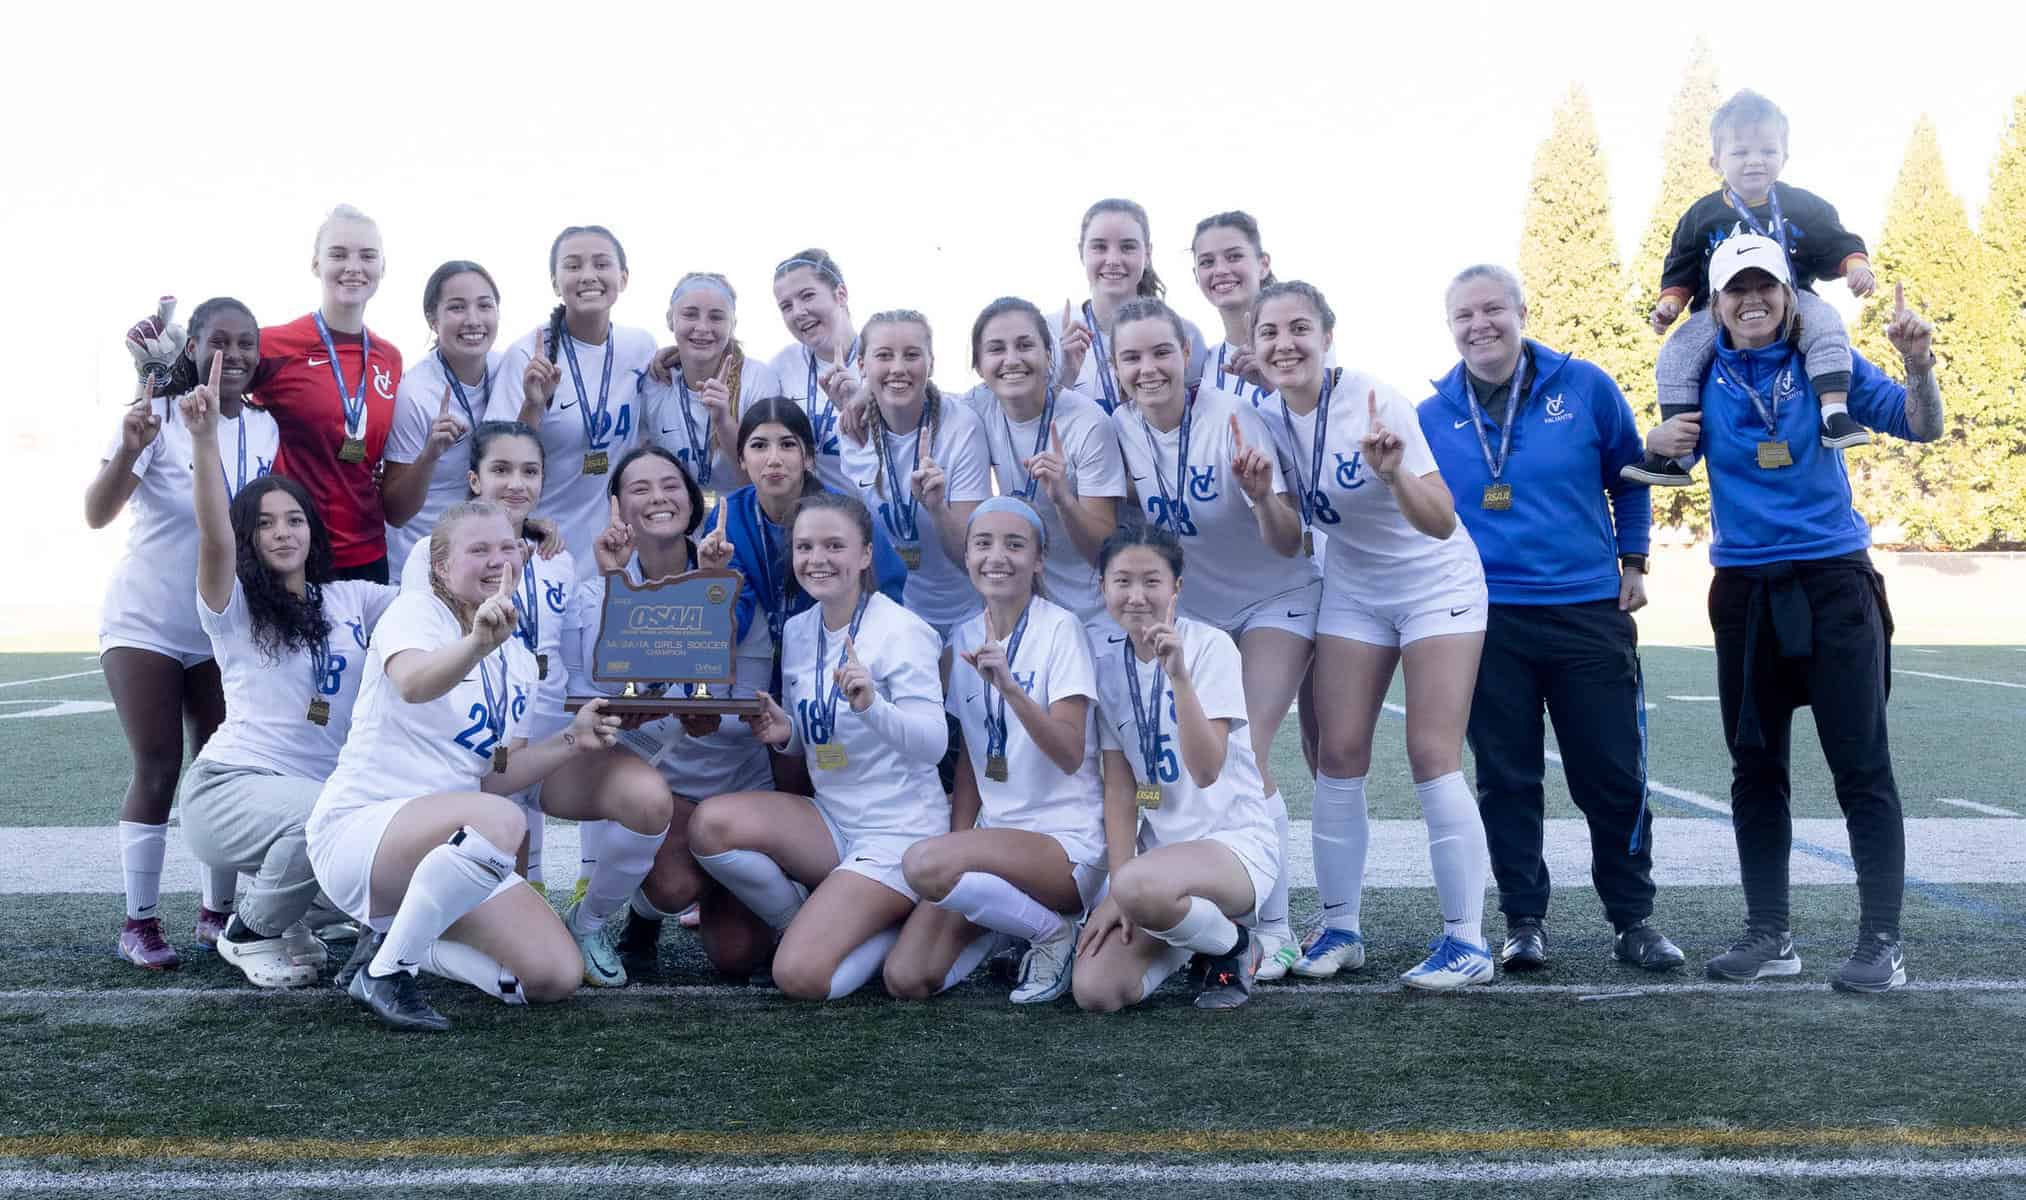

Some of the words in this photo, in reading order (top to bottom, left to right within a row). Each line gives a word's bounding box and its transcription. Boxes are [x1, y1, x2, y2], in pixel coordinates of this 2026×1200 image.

[372, 364, 395, 400] VC
[1544, 393, 1565, 416] VC
[590, 404, 631, 449] 24
[1189, 465, 1218, 501] VC
[1332, 451, 1366, 489] VC
[541, 579, 566, 614] VC
[629, 605, 704, 630] OSAA
[654, 640, 683, 649] GIRLS
[687, 640, 729, 649] SOCCER
